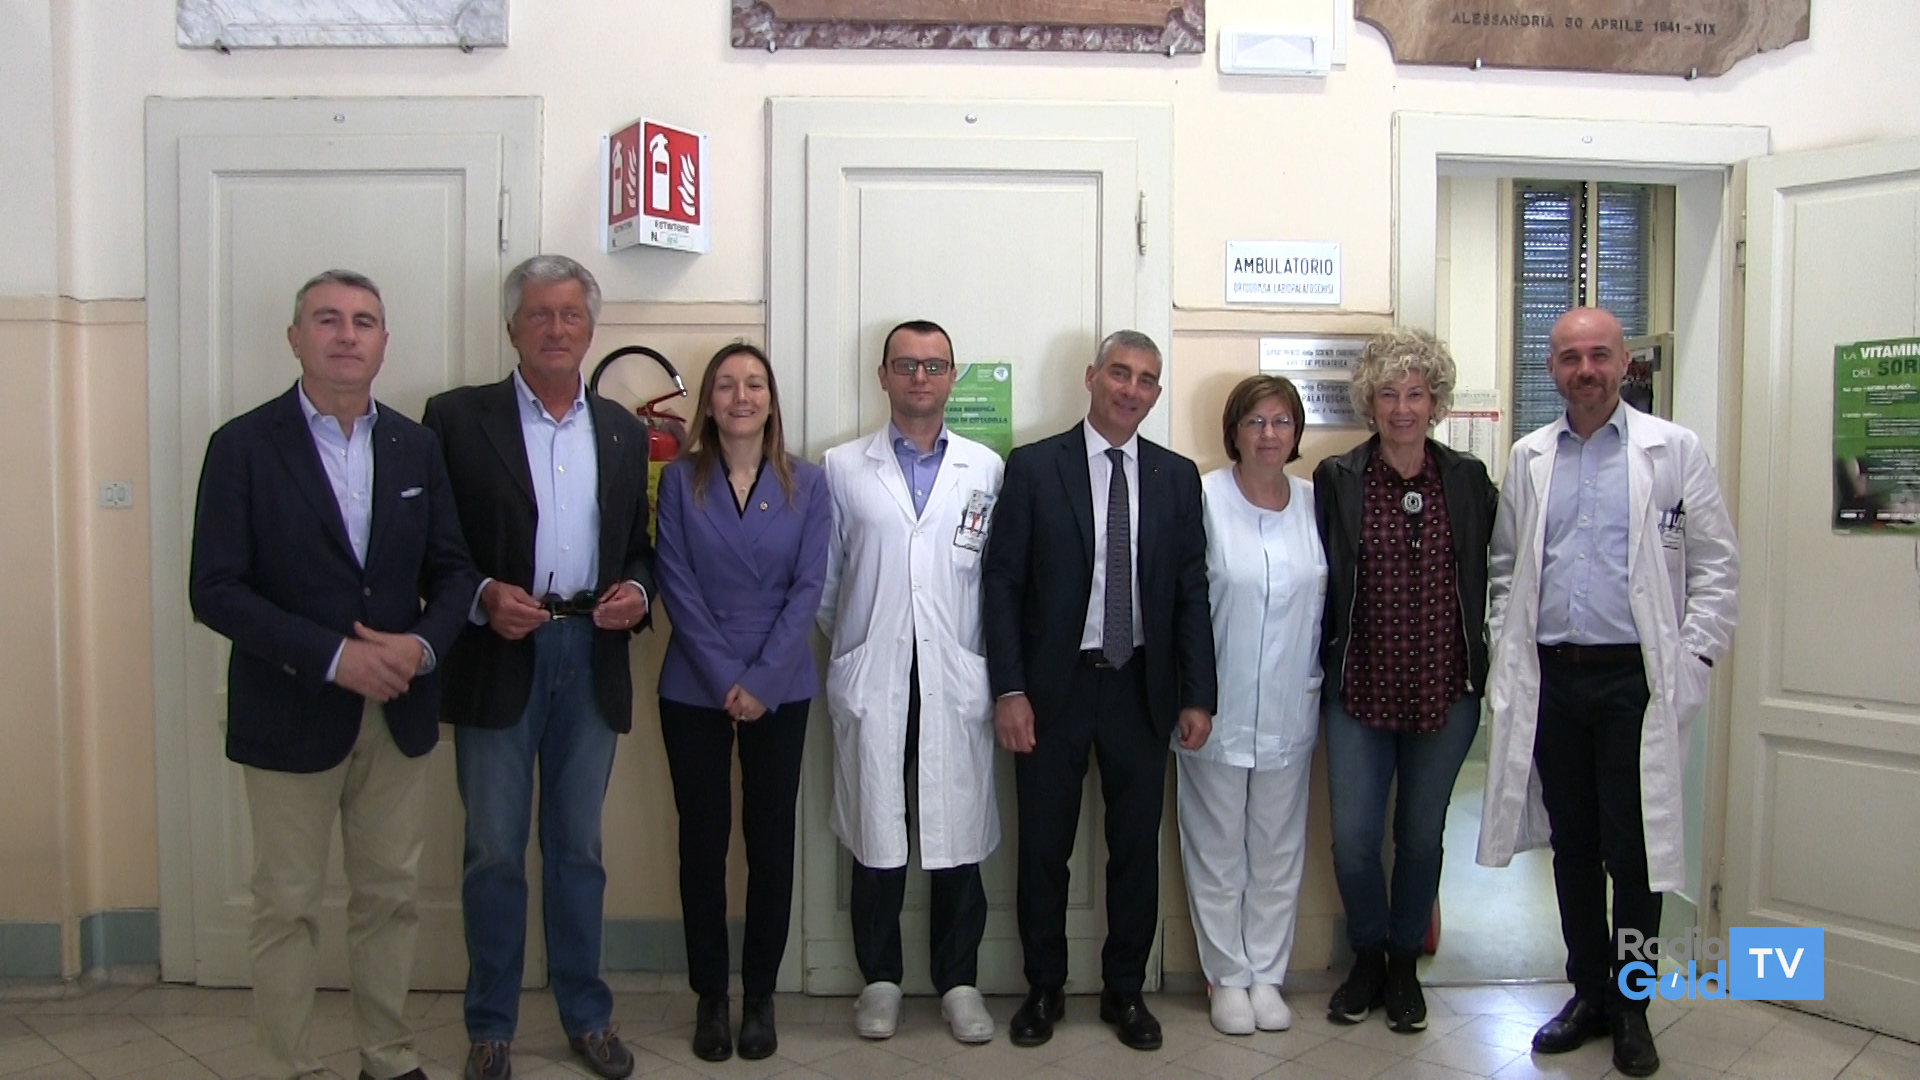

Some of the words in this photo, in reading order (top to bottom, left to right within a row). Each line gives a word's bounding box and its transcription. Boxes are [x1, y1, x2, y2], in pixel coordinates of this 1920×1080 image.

[1451, 12, 1555, 28] ALESSANDRIA
[1565, 16, 1583, 28] 30
[1591, 18, 1644, 32] APRILE
[1233, 257, 1334, 276] AMBULATORIO
[1843, 352, 1857, 360] LA
[1860, 343, 1920, 360] VITAMIN
[1852, 369, 1873, 378] DEL
[1878, 359, 1920, 376] SOR
